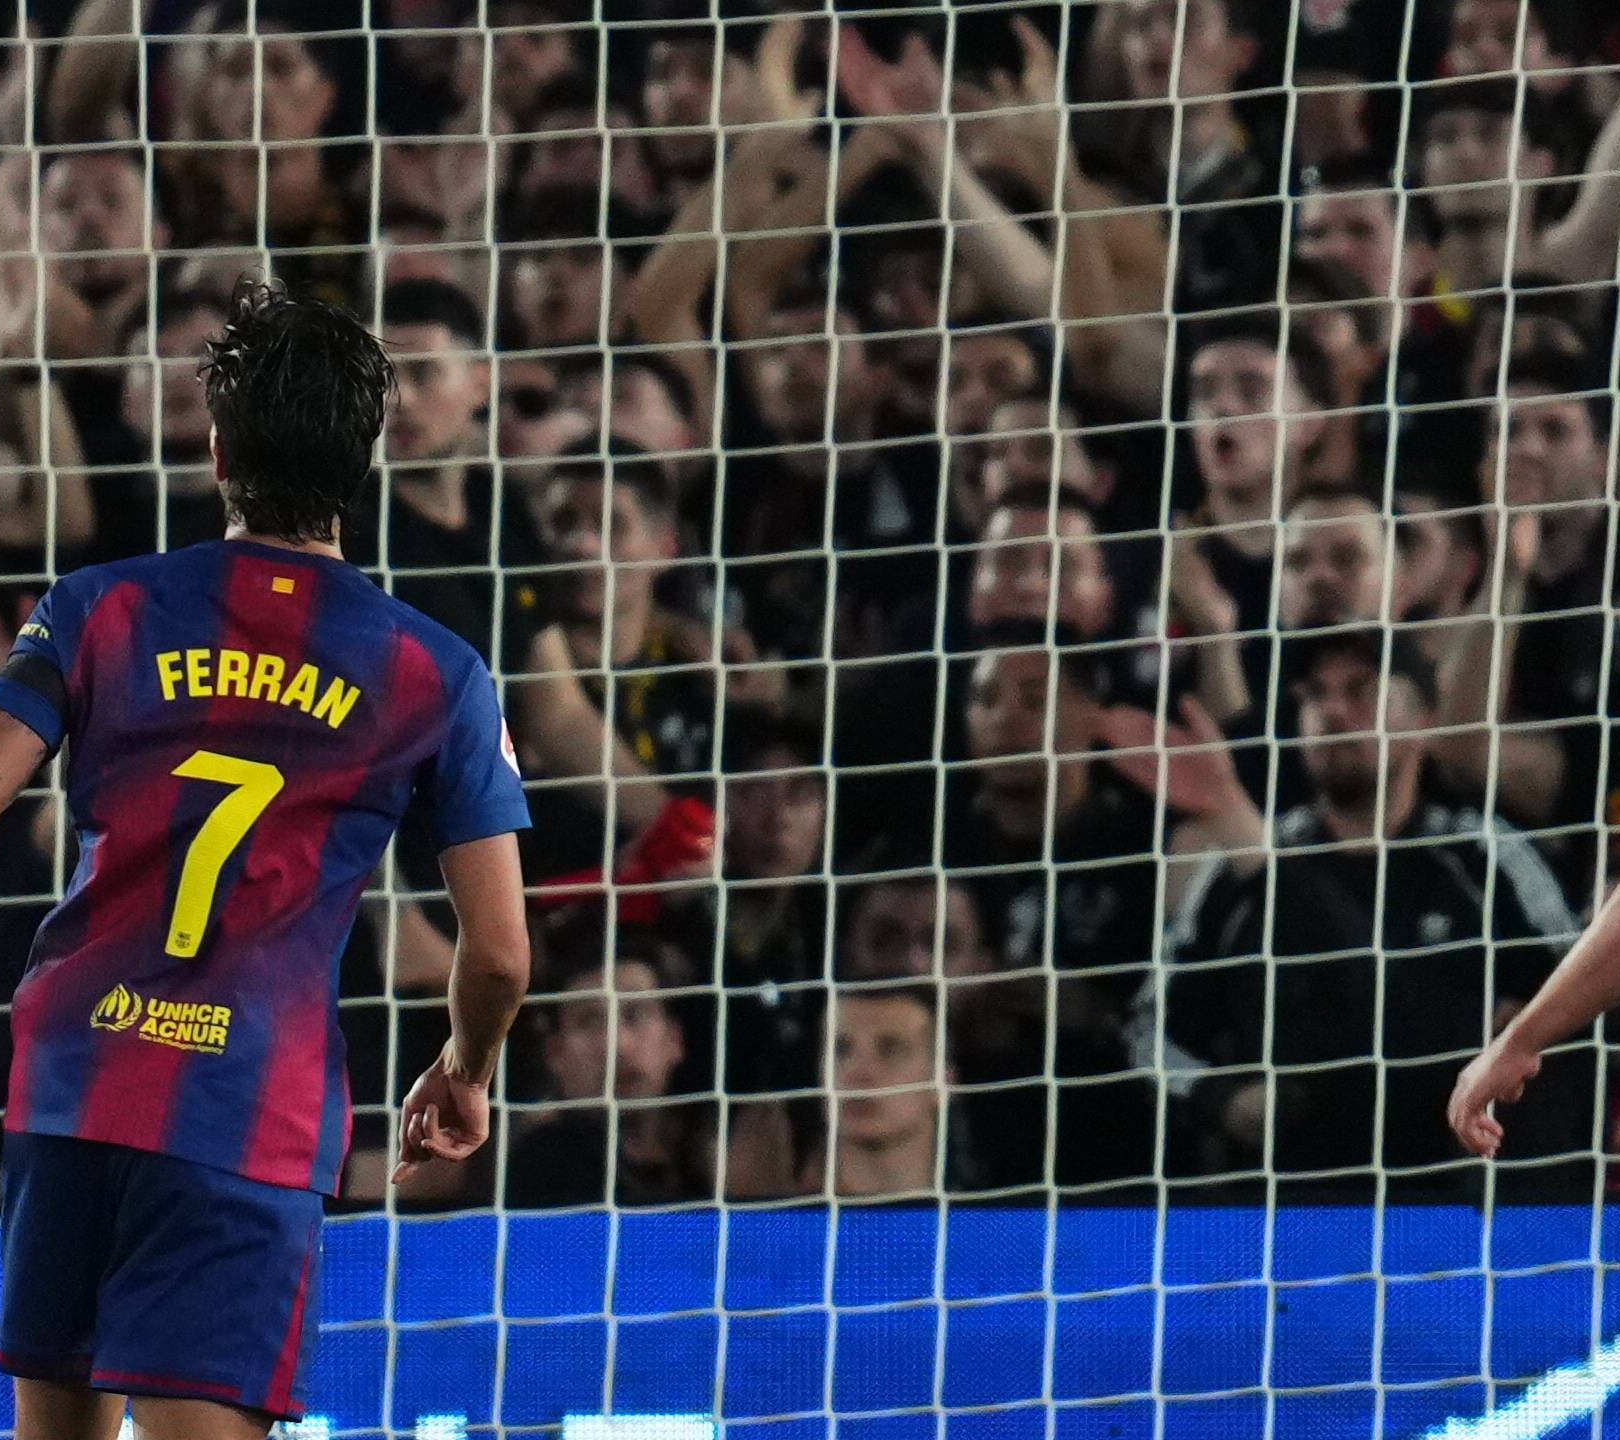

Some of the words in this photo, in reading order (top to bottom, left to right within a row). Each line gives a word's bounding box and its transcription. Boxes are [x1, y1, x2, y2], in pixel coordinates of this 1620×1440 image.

[156, 648, 361, 730] FERRAN
[164, 749, 285, 959] 7
[138, 1017, 228, 1046] ACNUR
[147, 998, 232, 1027] UNHCR
